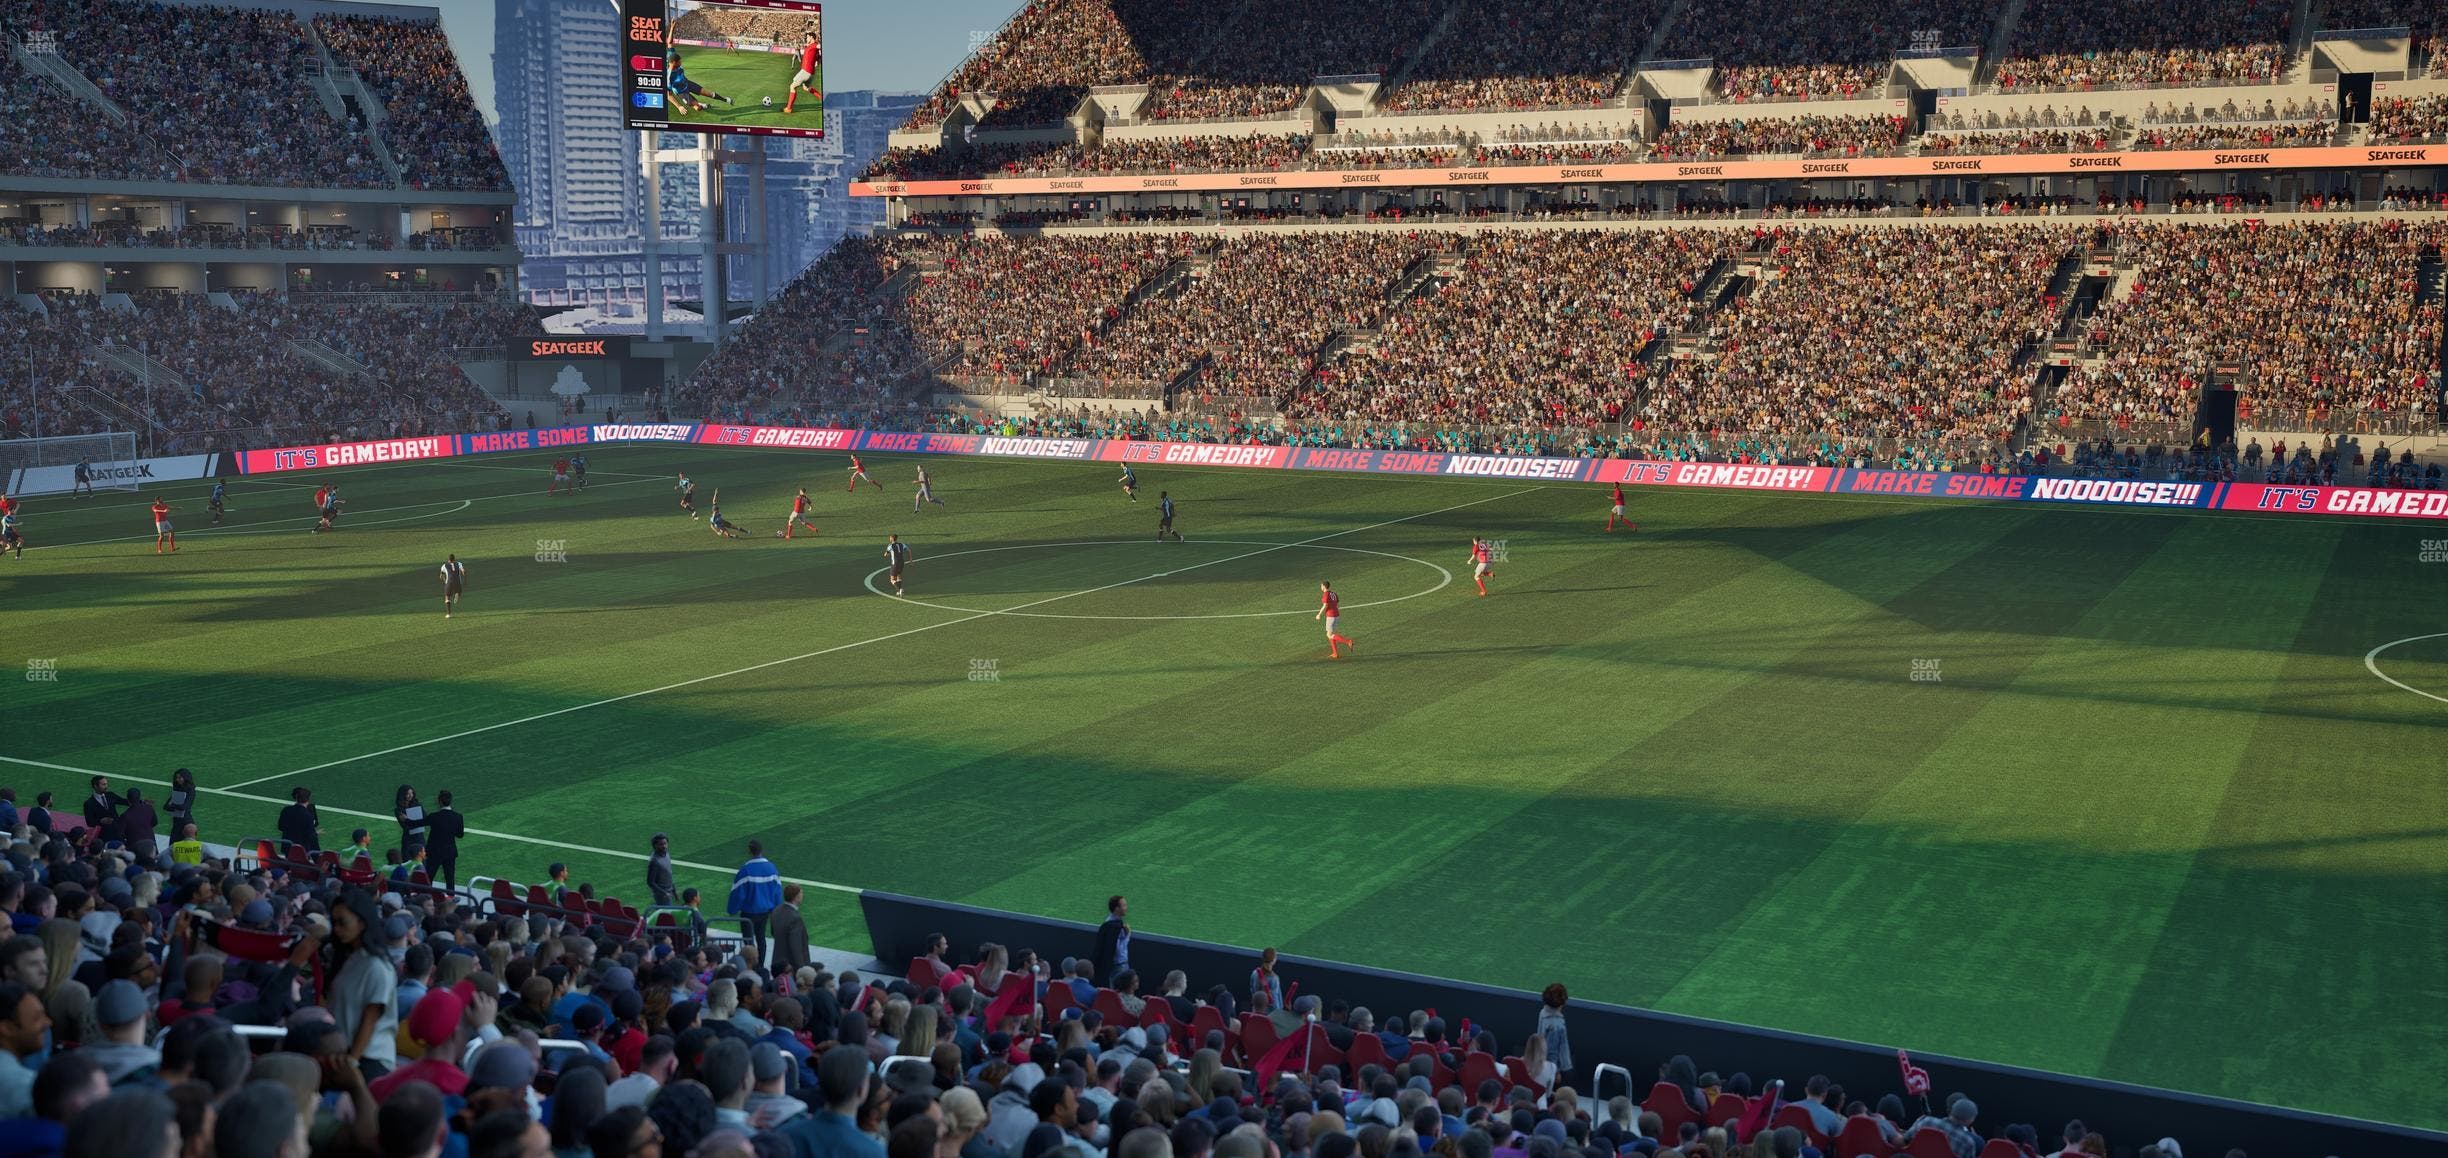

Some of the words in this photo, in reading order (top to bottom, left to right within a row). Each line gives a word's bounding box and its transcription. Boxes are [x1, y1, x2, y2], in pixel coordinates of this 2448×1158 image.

[631, 16, 661, 29] SEAT
[630, 29, 663, 43] GEEK
[637, 77, 661, 87] 90:00
[652, 96, 658, 105] 2
[2214, 153, 2269, 165] SEATGEEK
[2367, 149, 2426, 161] SEATGEEK
[1802, 162, 1849, 174] SEATGEEK
[1932, 159, 1981, 171] SEATGEEK
[2069, 156, 2121, 168] SEATGEEK
[1449, 171, 1489, 181] SEATGEEK
[1560, 168, 1603, 179] SEATGEEK
[1678, 166, 1722, 177] SEATGEEK
[1050, 180, 1084, 190] SEATGEEK
[1143, 178, 1178, 189] SEATGEEK
[1240, 176, 1277, 186] SEATGEEK
[1342, 174, 1380, 184] SEATGEEK
[875, 185, 906, 194] SEATGEEK
[961, 183, 993, 192] SEATGEEK
[531, 339, 606, 357] SEATGEEK
[472, 431, 529, 452] MAKE
[538, 426, 588, 446] SOME
[594, 425, 692, 442] NOOOOISE!!!
[717, 427, 751, 443] IT'S
[753, 428, 844, 448] GAMEDAY!
[866, 432, 922, 450] MAKE
[925, 436, 979, 453] SOME
[981, 437, 1090, 458] NOOOOISE!!!
[275, 450, 317, 469] IT'S
[326, 439, 438, 465] GAMEDAY!
[1122, 442, 1162, 460] IT'S
[1165, 444, 1276, 465] GAMEDAY!
[1304, 450, 1373, 469] MAKE
[1379, 454, 1444, 472] SOME
[1446, 455, 1580, 478] NOOOOISE!!!
[88, 463, 154, 481] EATGEEK
[1624, 462, 1671, 482] IT'S
[1677, 464, 1815, 488] GAMEDAY!
[1851, 470, 1937, 494] MAKE
[1945, 475, 2028, 498] SOME
[2031, 478, 2202, 505] NOOOOISE!!!
[2258, 487, 2319, 509] IT'S
[2327, 489, 2448, 517] GAMED
